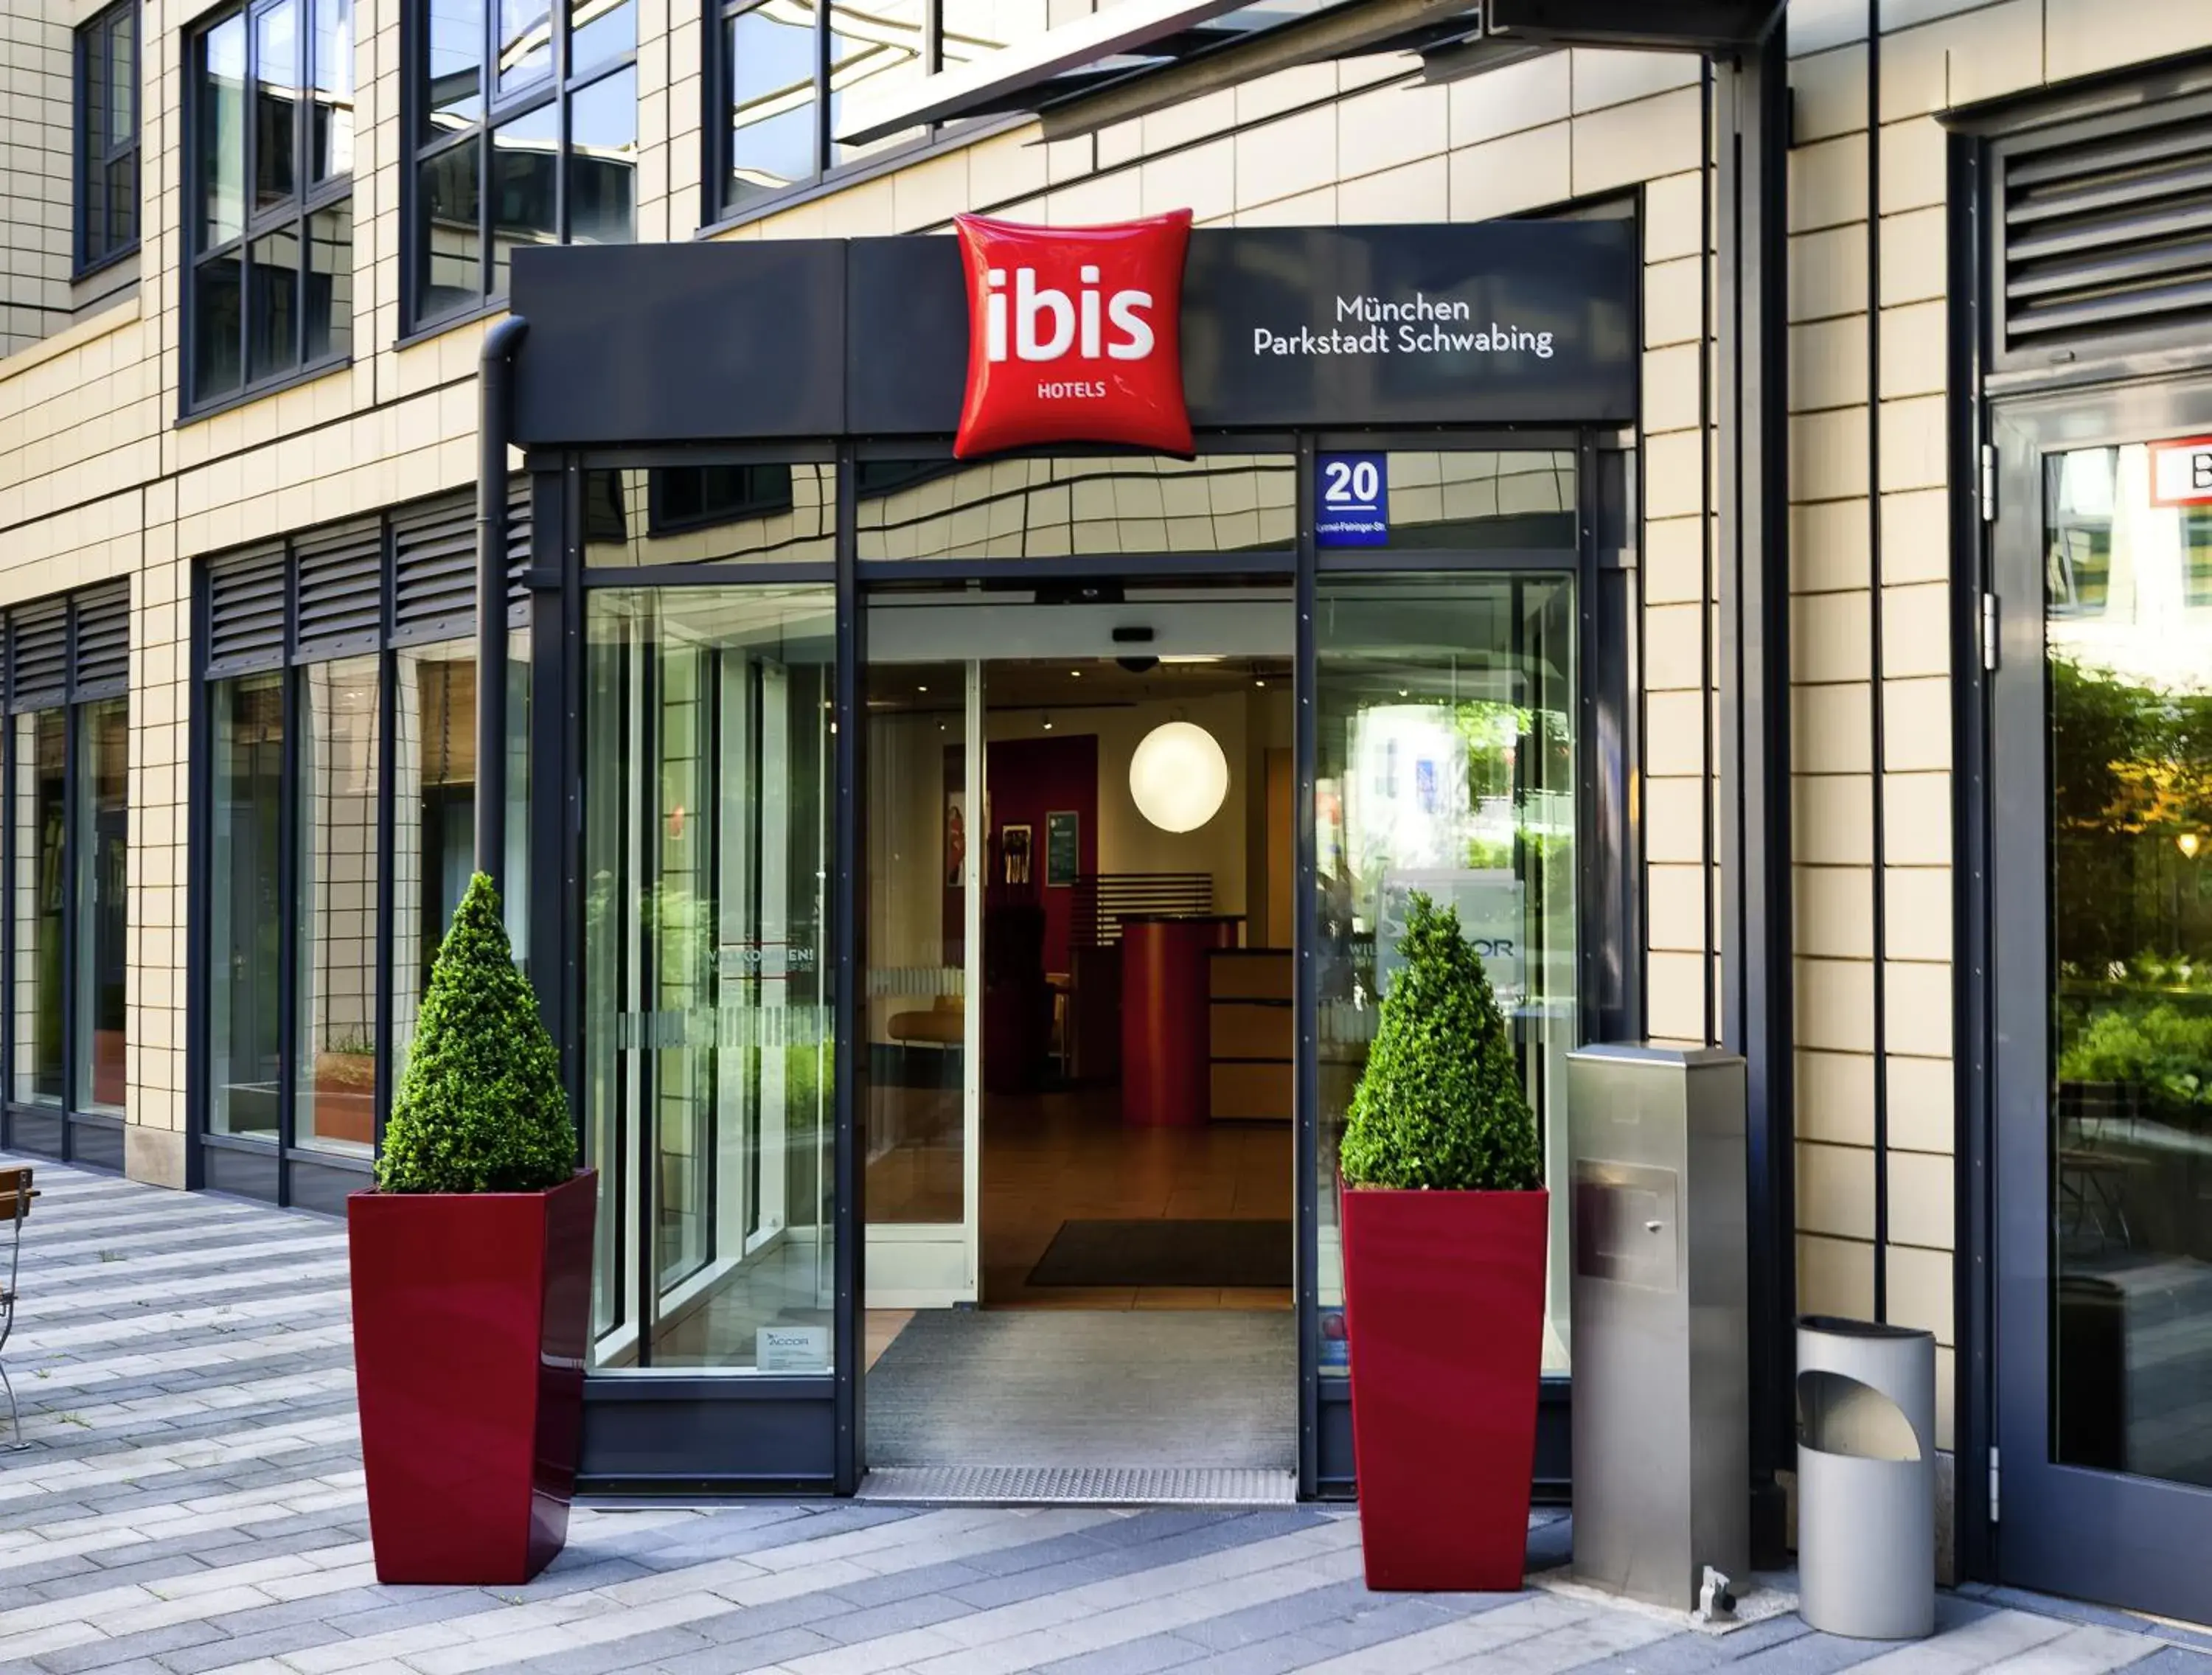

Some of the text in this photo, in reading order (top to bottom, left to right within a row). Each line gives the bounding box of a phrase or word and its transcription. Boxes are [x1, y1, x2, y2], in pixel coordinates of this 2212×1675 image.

[987, 266, 1155, 362] ibis
[1337, 292, 1470, 322] München
[1254, 324, 1554, 358] Parkstadt Schwabing
[1037, 381, 1105, 399] HOTELS
[1325, 462, 1379, 502] 20
